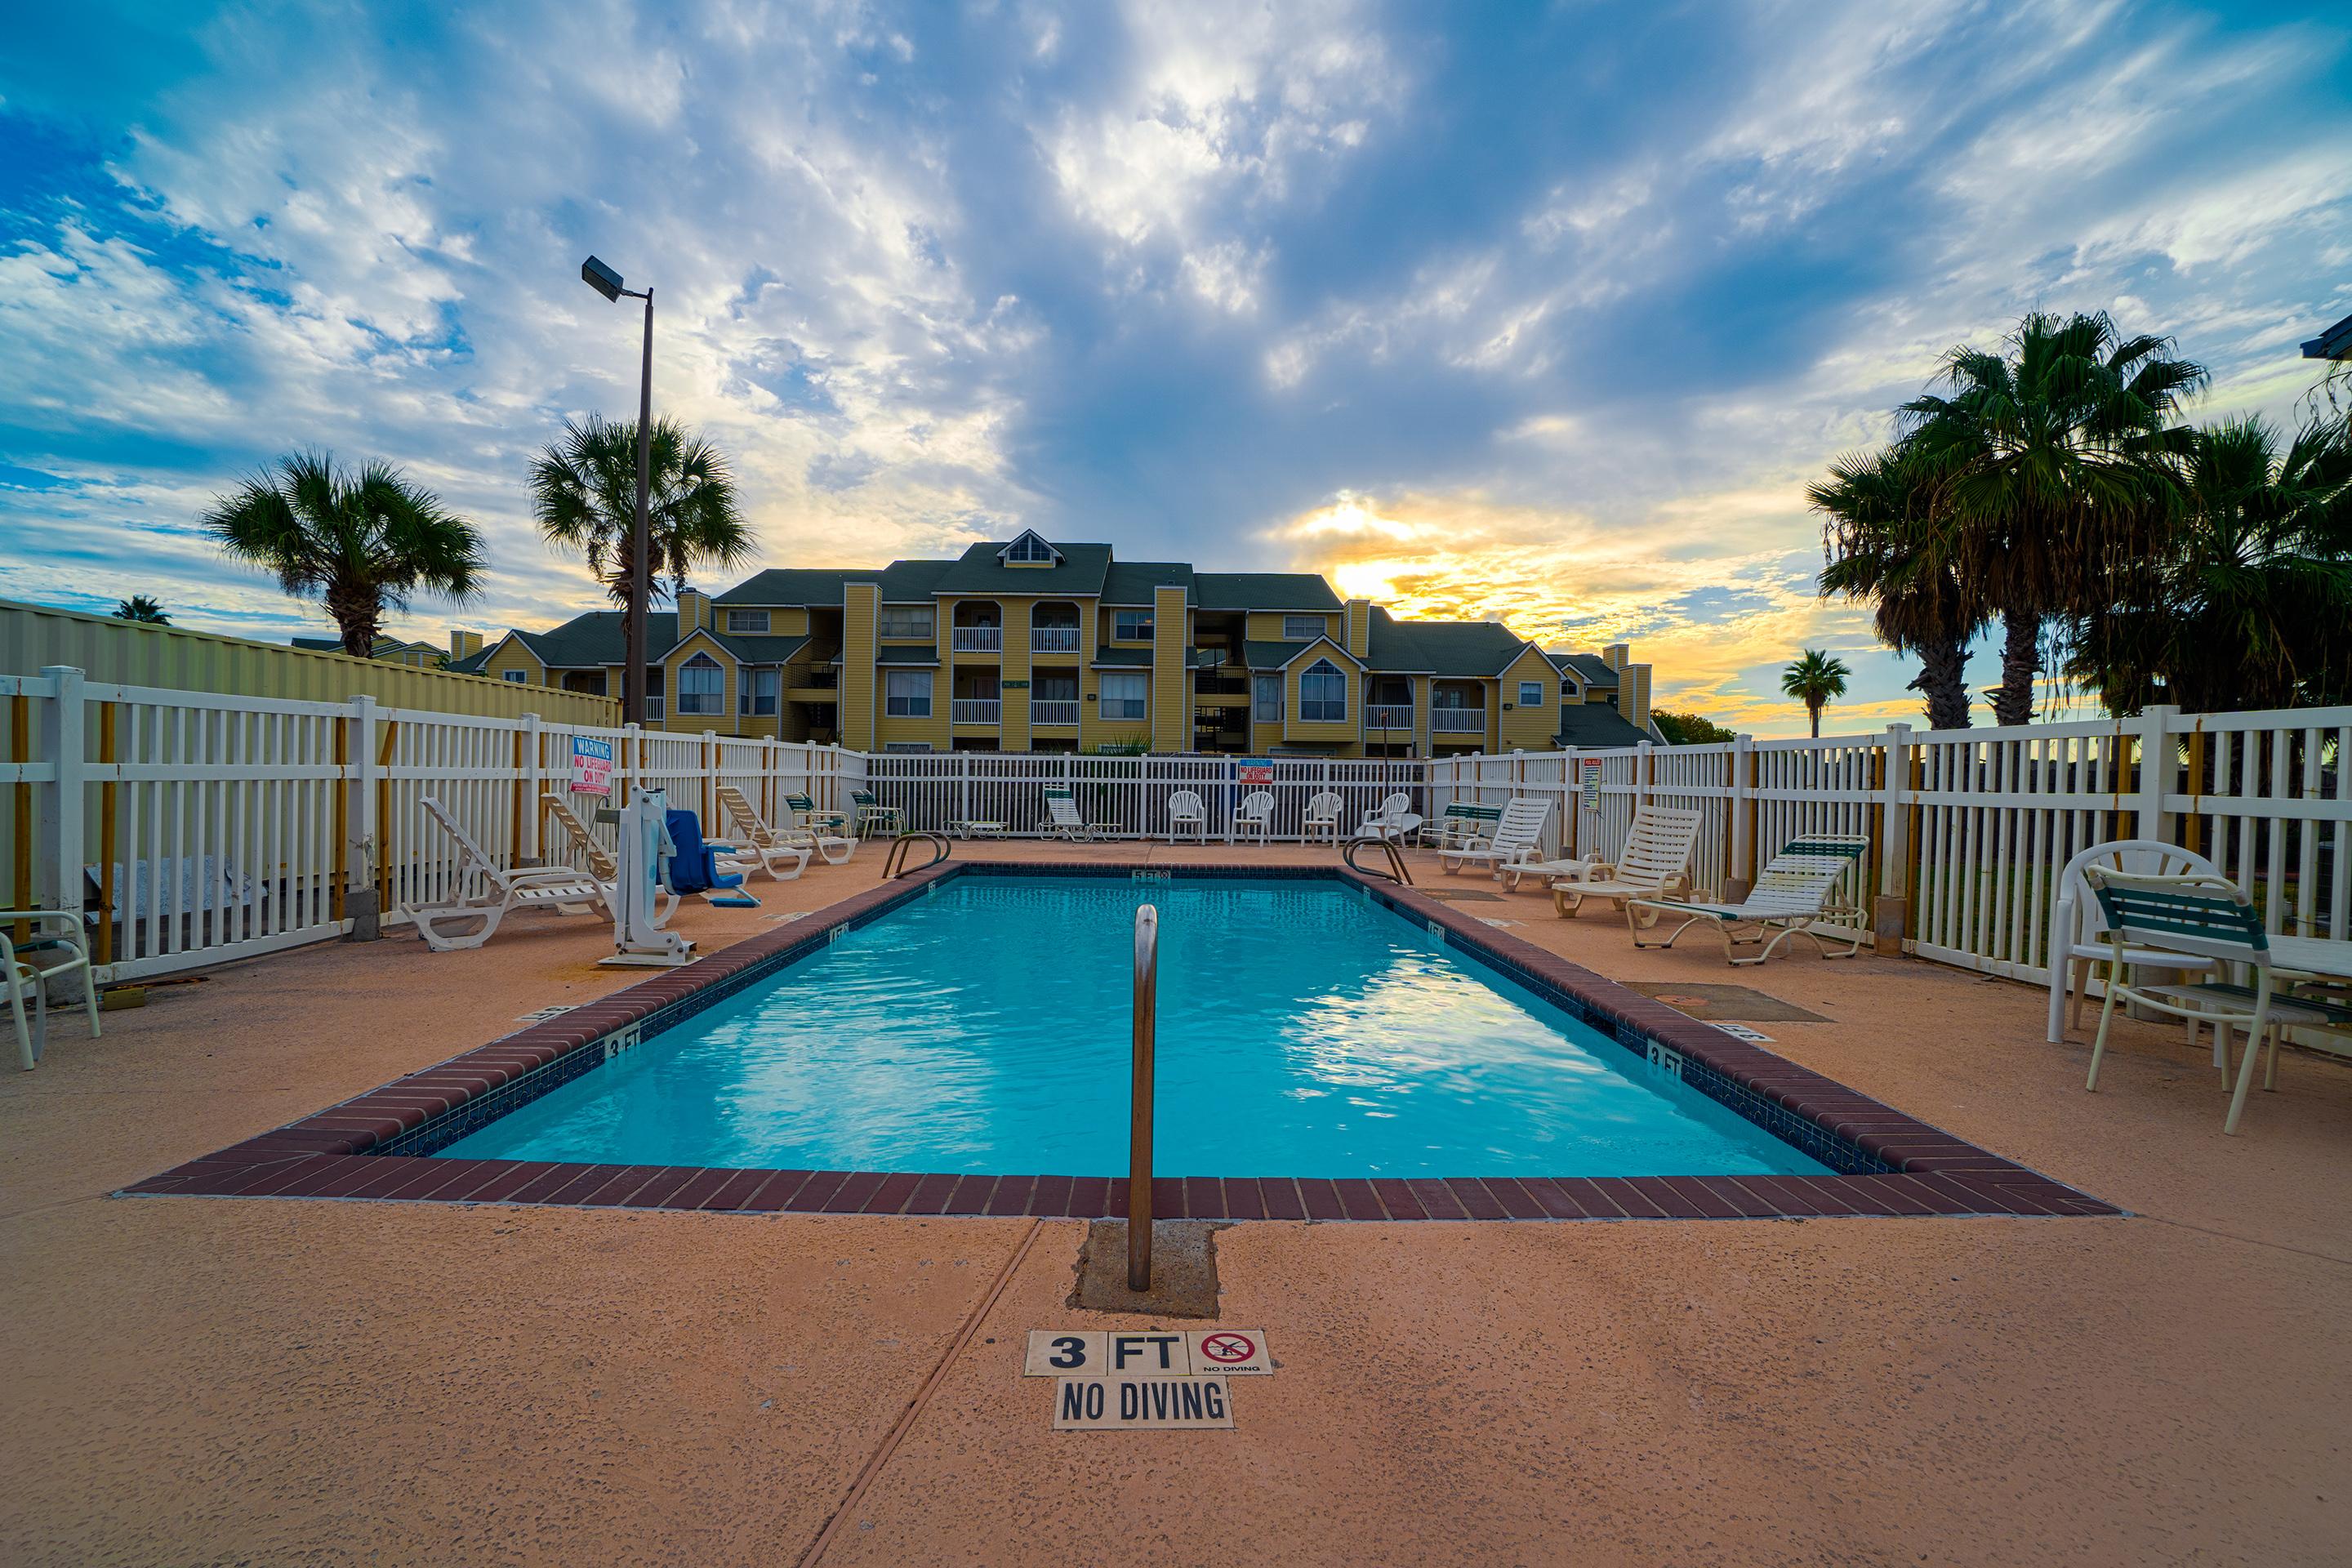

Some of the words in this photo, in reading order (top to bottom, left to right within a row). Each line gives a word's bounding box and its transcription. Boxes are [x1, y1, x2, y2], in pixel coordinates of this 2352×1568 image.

[577, 738, 610, 759] WARNING
[574, 755, 584, 768] NO
[586, 757, 612, 772] LIFEGUARD
[584, 770, 593, 782] ON
[595, 772, 605, 785] DUTY
[1135, 871, 1142, 880] 5
[1146, 871, 1157, 881] FT
[610, 1040, 619, 1059] 3
[625, 1028, 639, 1051] FT
[1651, 1047, 1659, 1065] 3
[1664, 1053, 1681, 1076] FT
[1049, 1337, 1086, 1369] 3
[1116, 1336, 1180, 1370] FT
[1062, 1383, 1104, 1420] NO
[1120, 1382, 1225, 1420] DIVING
